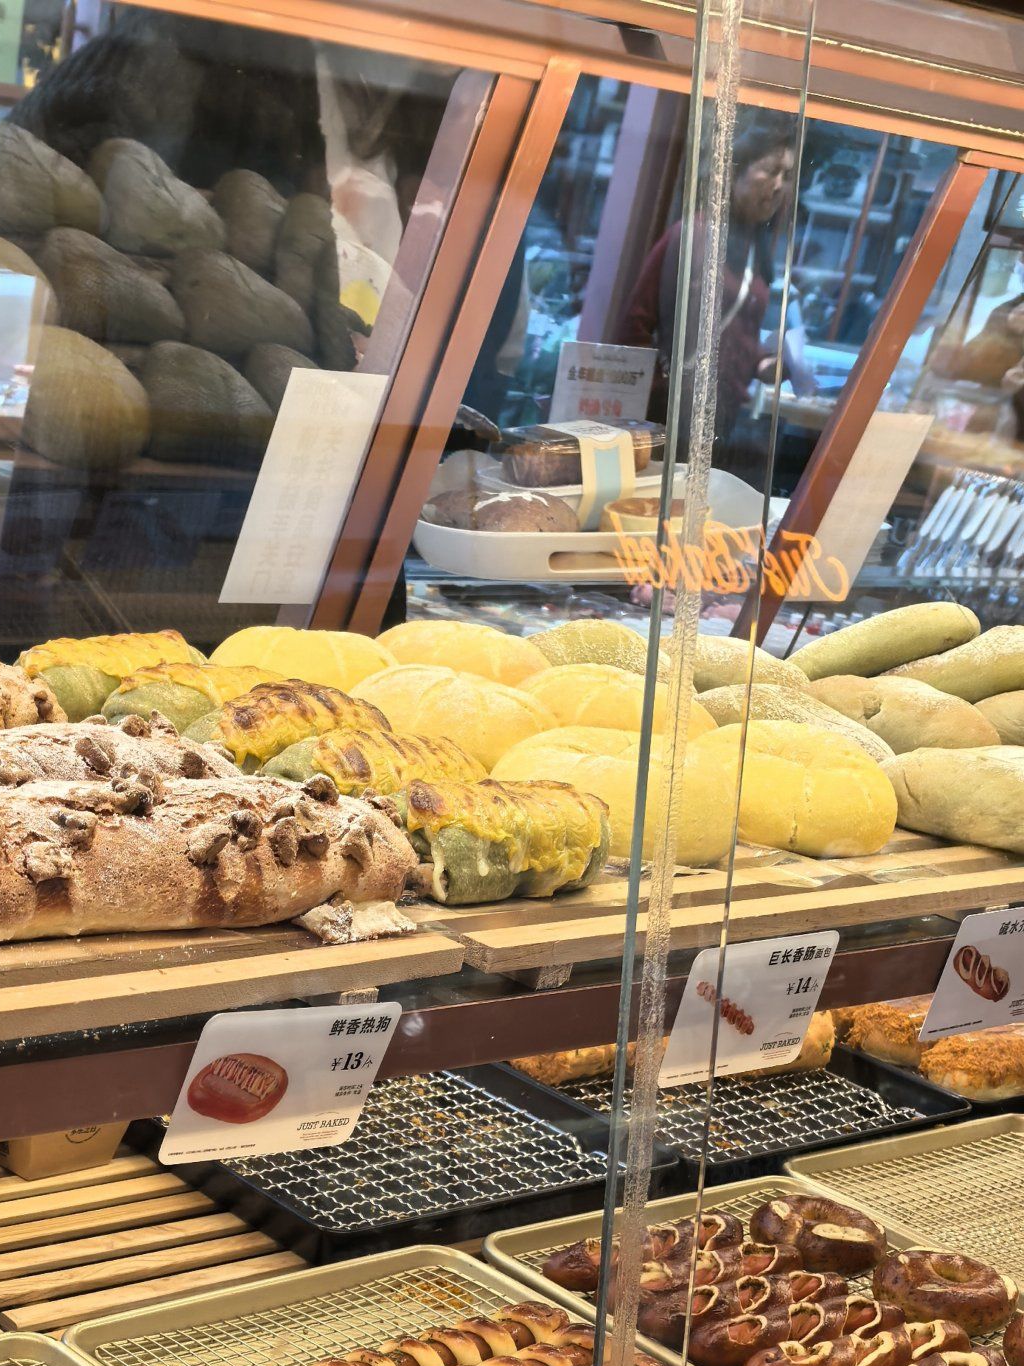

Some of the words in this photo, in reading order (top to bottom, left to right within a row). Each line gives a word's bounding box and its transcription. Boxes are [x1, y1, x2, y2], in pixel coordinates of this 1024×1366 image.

[329, 1015, 392, 1036] 鲜香热狗
[296, 1121, 319, 1131] JUST
[319, 1117, 350, 1129] BAKED
